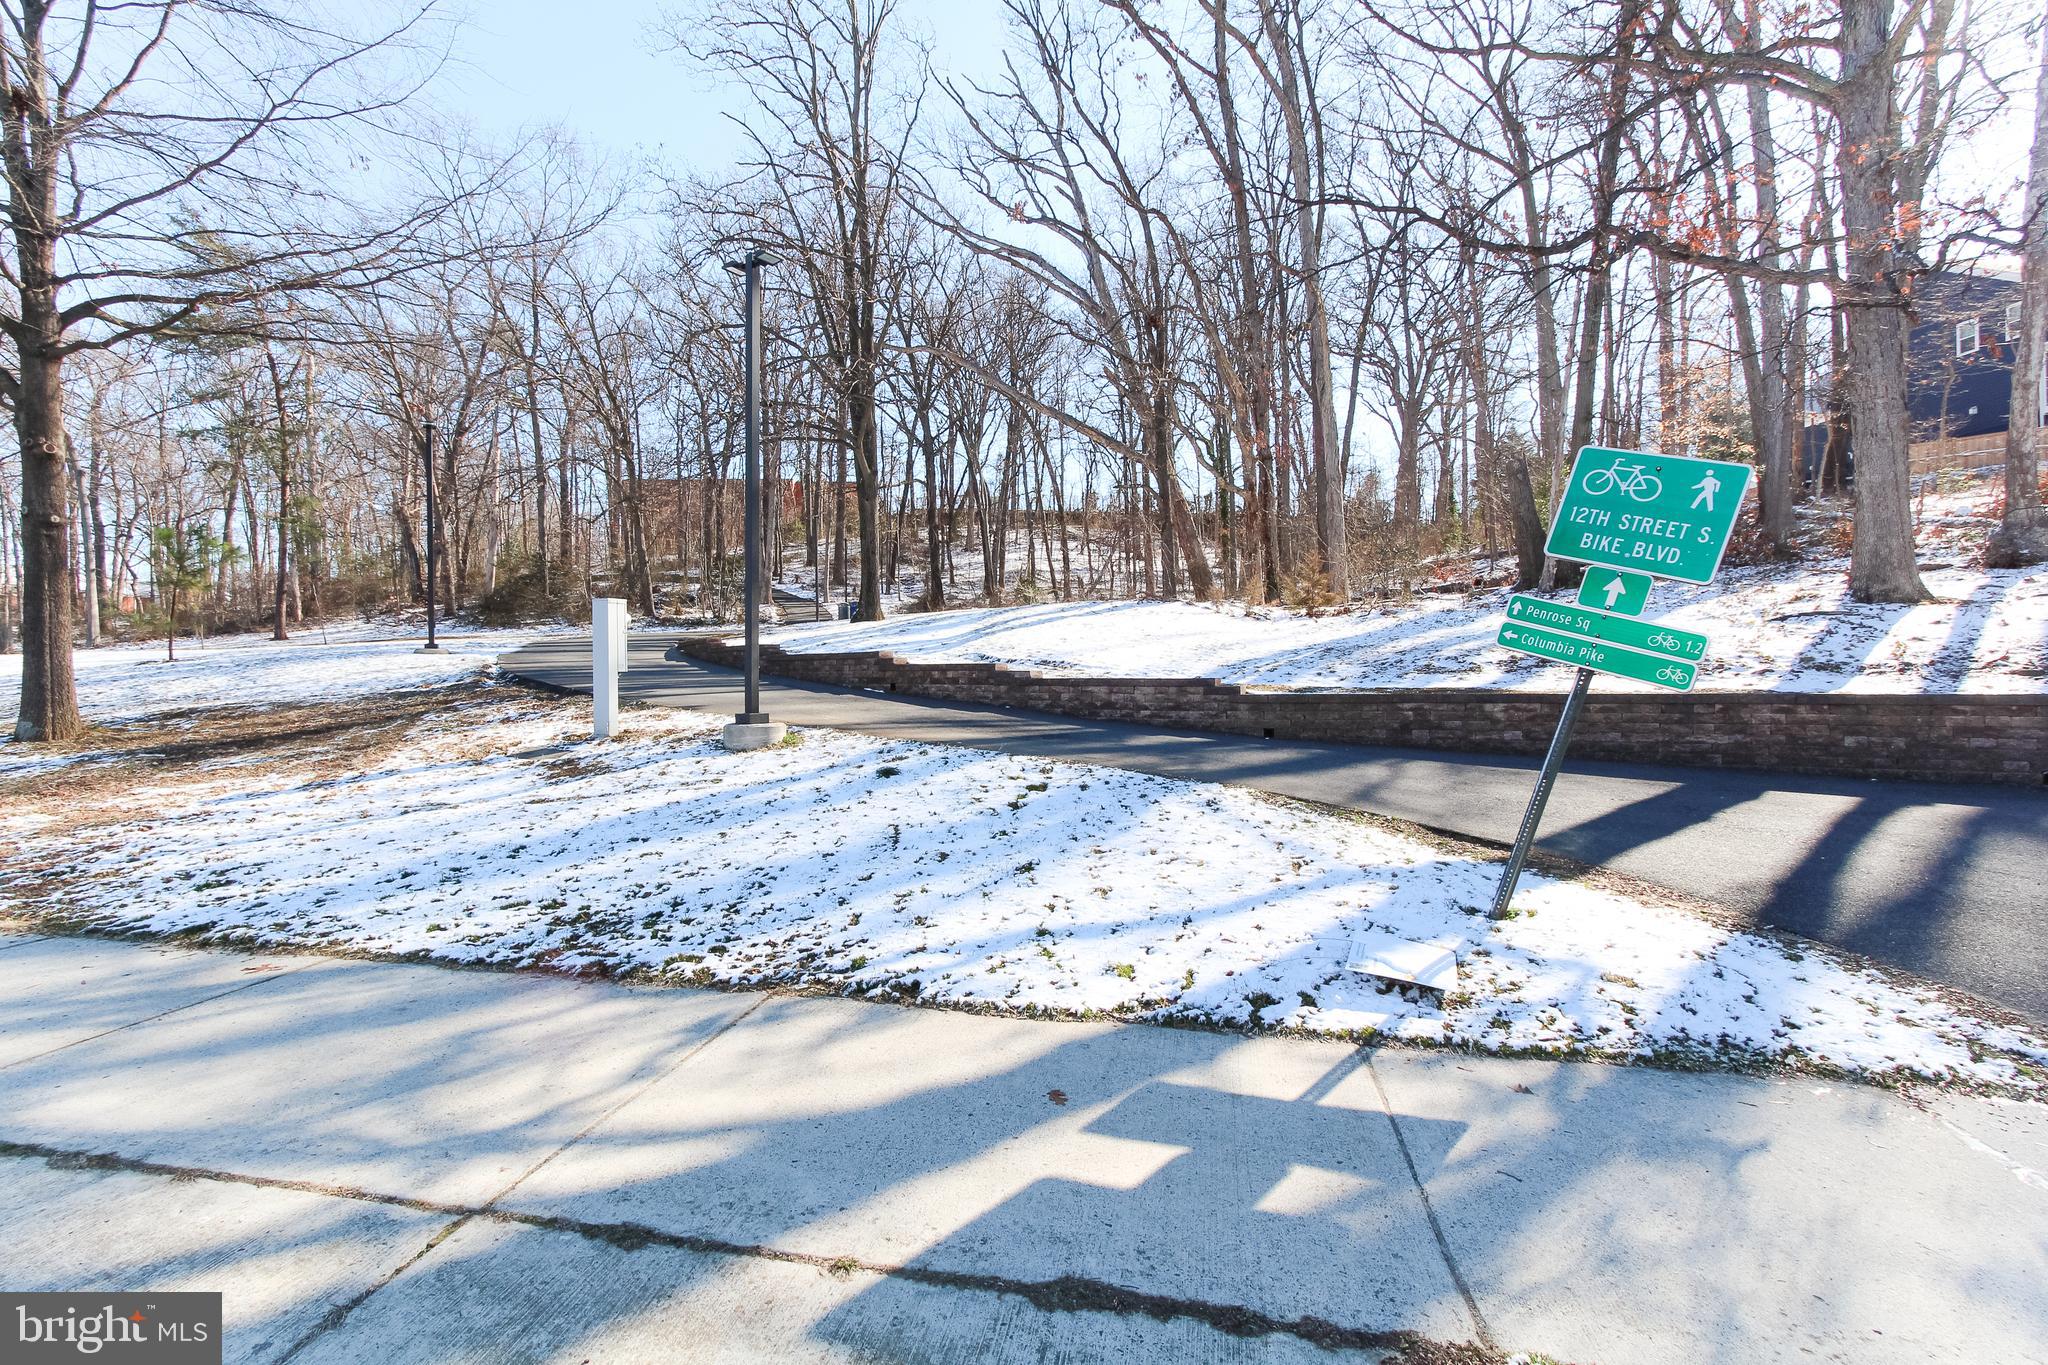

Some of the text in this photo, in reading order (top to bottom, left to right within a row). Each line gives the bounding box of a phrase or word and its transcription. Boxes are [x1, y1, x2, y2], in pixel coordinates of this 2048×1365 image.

[1569, 505, 1715, 545] 12TH STREET S.
[1580, 532, 1624, 555] BIKE
[1526, 605, 1703, 655] Penrose Sq 1.2
[1521, 633, 1605, 664] Columbia Pike
